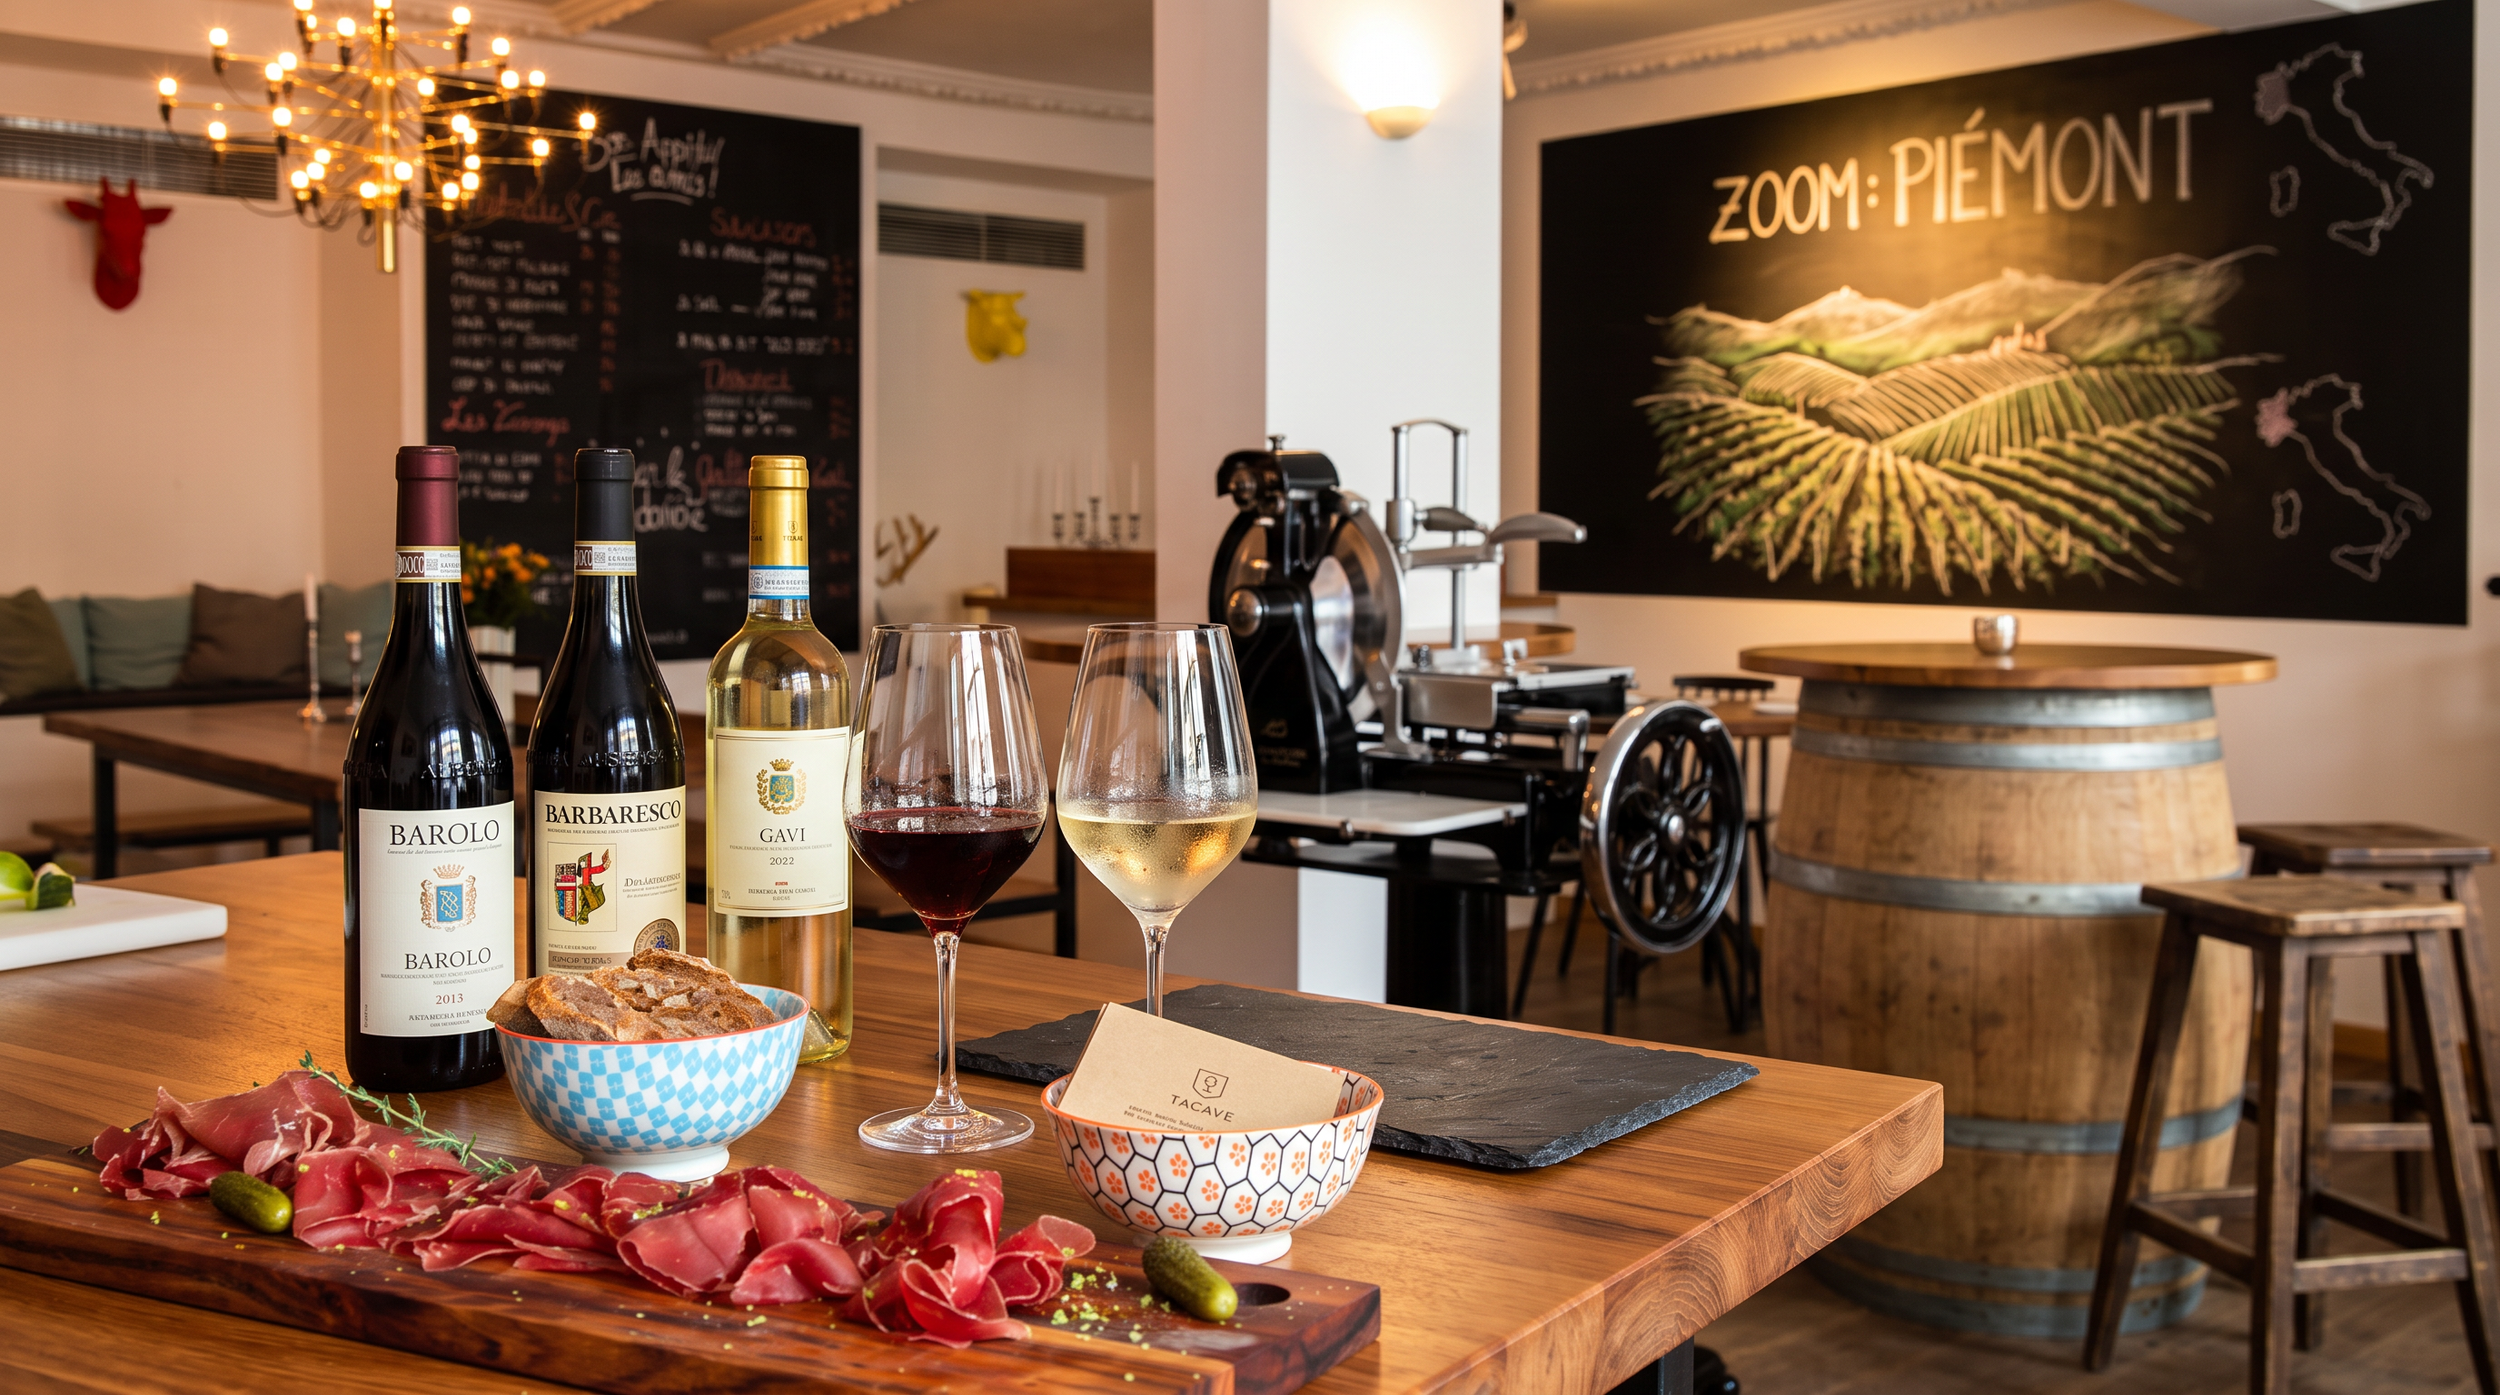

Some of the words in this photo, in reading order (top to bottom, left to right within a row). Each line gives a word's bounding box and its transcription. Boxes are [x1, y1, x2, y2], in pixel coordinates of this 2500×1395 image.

[1889, 99, 2213, 228] PIÉMONT
[545, 800, 681, 825] BARBARESCO
[389, 819, 500, 846] BAROLO
[759, 827, 806, 843] GAVI
[769, 857, 795, 866] 2022
[405, 947, 491, 970] BAROLO
[435, 992, 464, 1005] 2013
[1171, 1094, 1235, 1123] TACAVE
